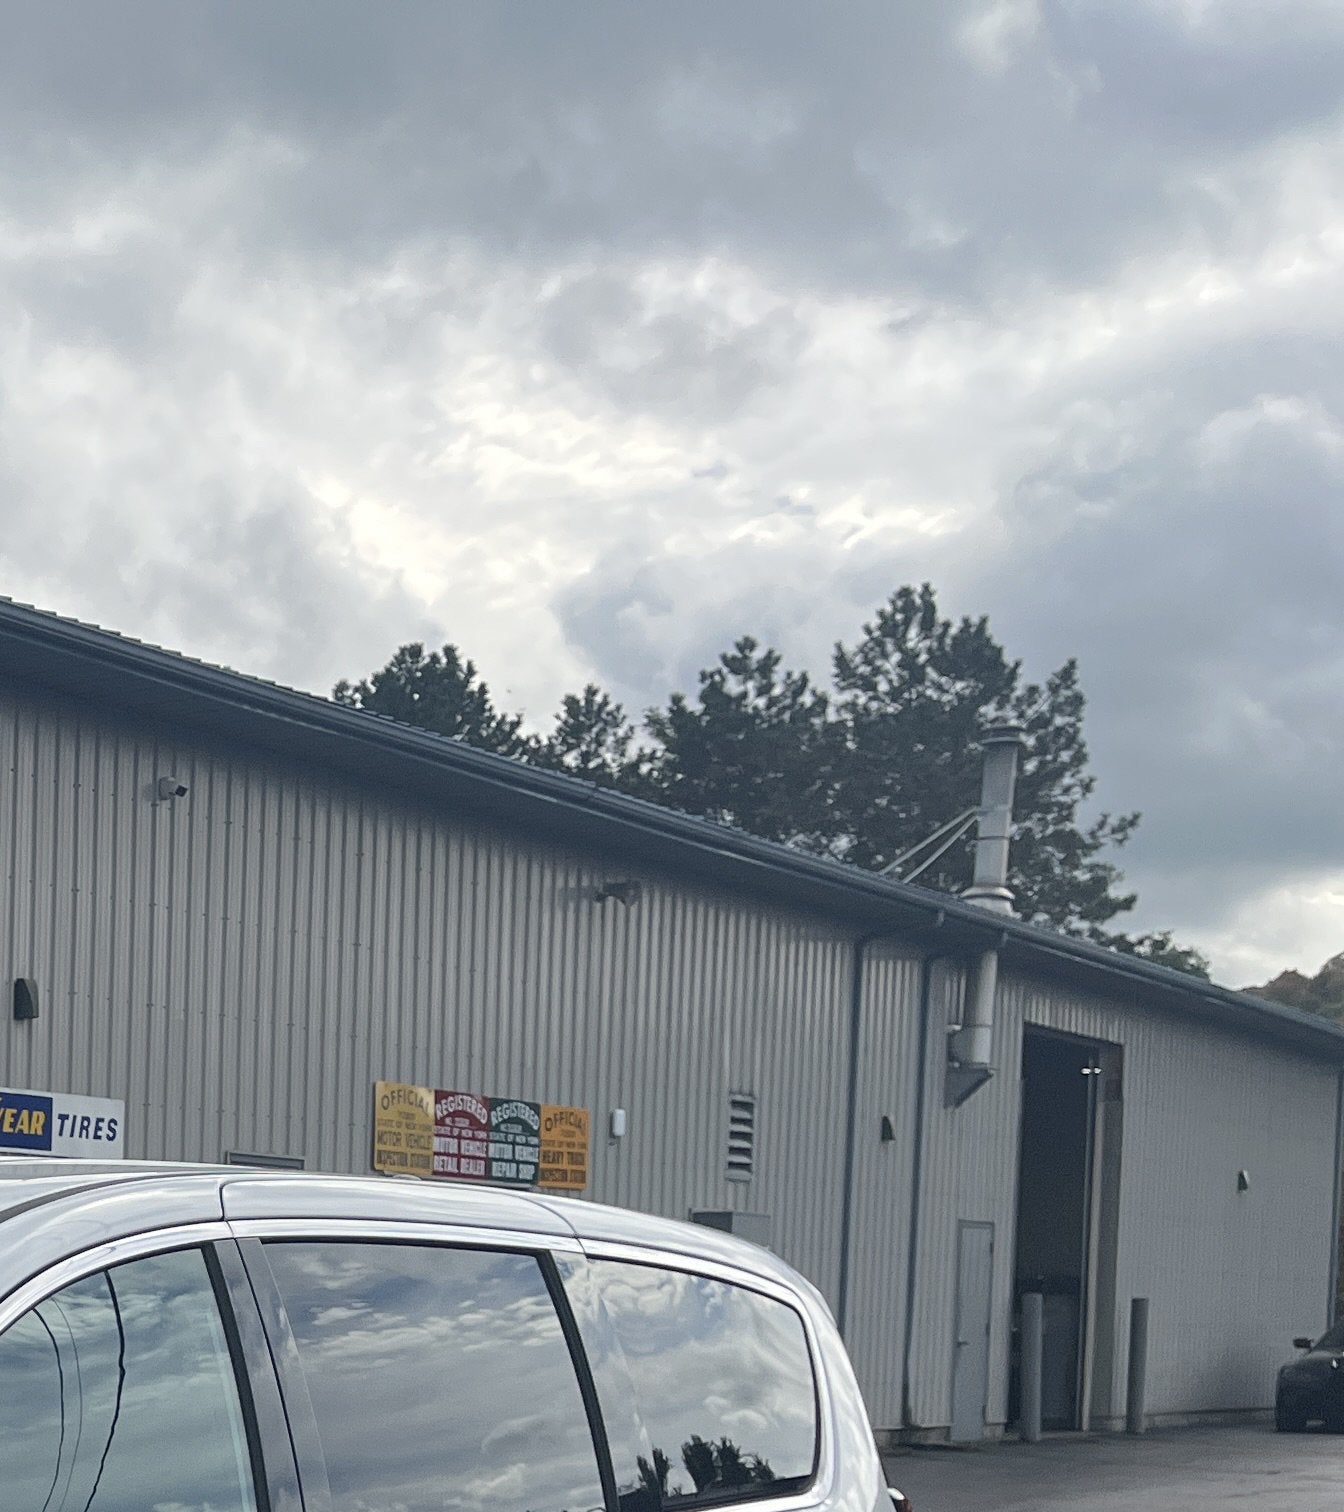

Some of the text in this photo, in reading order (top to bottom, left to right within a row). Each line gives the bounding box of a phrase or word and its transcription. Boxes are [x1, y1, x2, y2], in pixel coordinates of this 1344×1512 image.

[381, 1089, 430, 1116] OFFICIAL
[436, 1094, 487, 1124] REGISTERED
[491, 1101, 540, 1130] REGISTERED
[57, 1113, 118, 1142] TIRES
[377, 1130, 402, 1146] MOTOR
